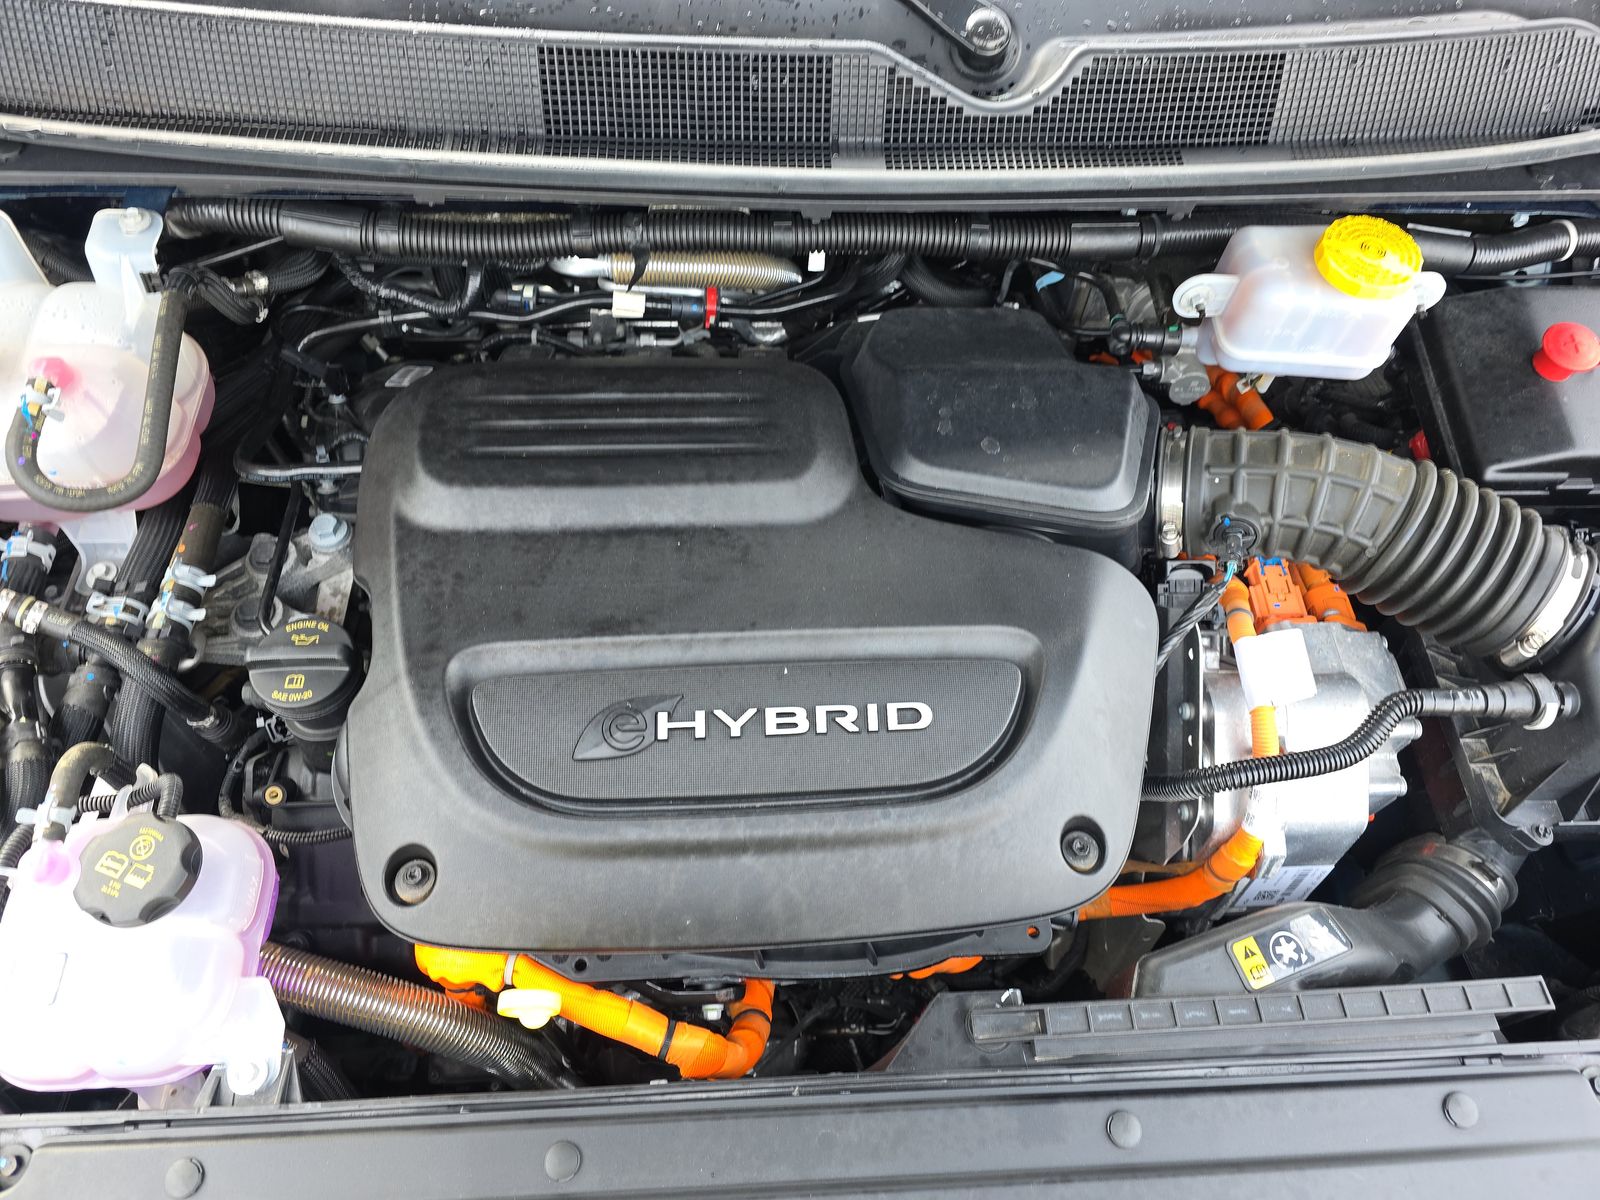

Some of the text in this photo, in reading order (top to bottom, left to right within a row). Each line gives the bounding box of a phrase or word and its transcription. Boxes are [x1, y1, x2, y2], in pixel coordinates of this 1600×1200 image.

[286, 620, 329, 632] ENGINE OIL
[272, 690, 288, 702] SAE
